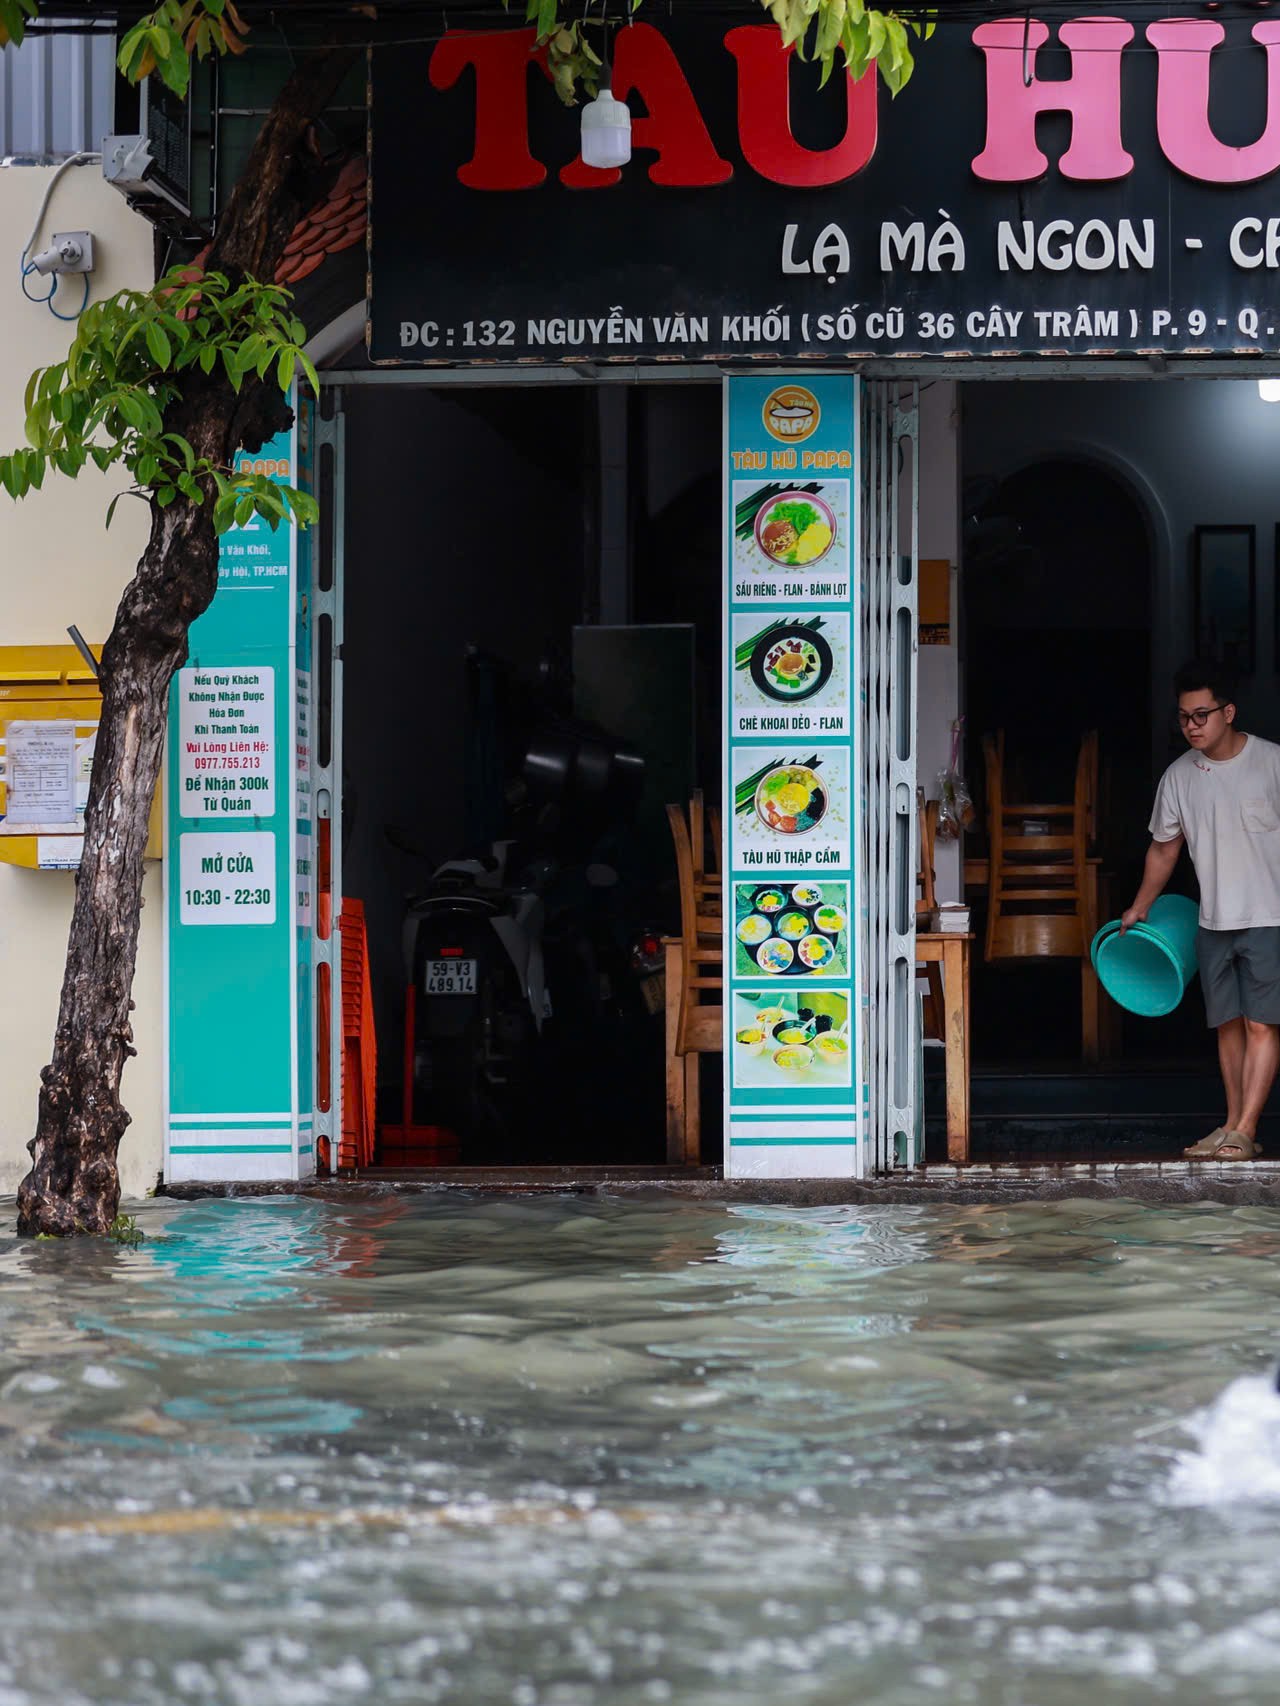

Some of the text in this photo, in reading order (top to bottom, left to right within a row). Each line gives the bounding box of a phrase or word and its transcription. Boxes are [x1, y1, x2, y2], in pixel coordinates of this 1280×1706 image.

[782, 222, 850, 284] LẠ
[880, 208, 965, 272] MÀ
[998, 219, 1154, 271] NGON
[462, 320, 515, 347] 132
[527, 305, 643, 345] NGUYỄN
[652, 312, 708, 343] VĂN
[722, 305, 790, 342] KHỐI
[865, 306, 905, 339] CŨ
[918, 313, 955, 338] 36
[966, 305, 1023, 338] CÂY
[731, 448, 767, 470] TÀU
[802, 450, 852, 469] PAPA
[253, 565, 289, 578] TP.HCM
[753, 581, 777, 596] RIÊNG
[784, 583, 803, 596] FLAN
[810, 581, 831, 596] BÁNH
[833, 583, 847, 599] LỌT
[194, 674, 259, 686] Nếu Quý Khách
[188, 691, 265, 703] Không Nhận Được
[209, 707, 245, 718] Hóa Đơn
[194, 723, 259, 735] Khi Thanh Toán
[739, 715, 758, 730] CHÈ
[760, 717, 789, 730] KHOAI
[792, 713, 810, 730] DẺO
[820, 717, 843, 730] FLAN
[186, 741, 269, 754] Vui Lòng Liên Hệ:
[194, 757, 260, 769] 0977.755.213
[185, 774, 269, 794] Để Nhận 300k
[203, 796, 252, 812] Từ Quán
[201, 851, 254, 873] MỞ CỬA
[742, 849, 763, 864] TÀU
[766, 849, 781, 864] HŨ
[784, 848, 812, 867] THẬP
[185, 889, 221, 905] 10:30
[234, 888, 271, 905] 22:30
